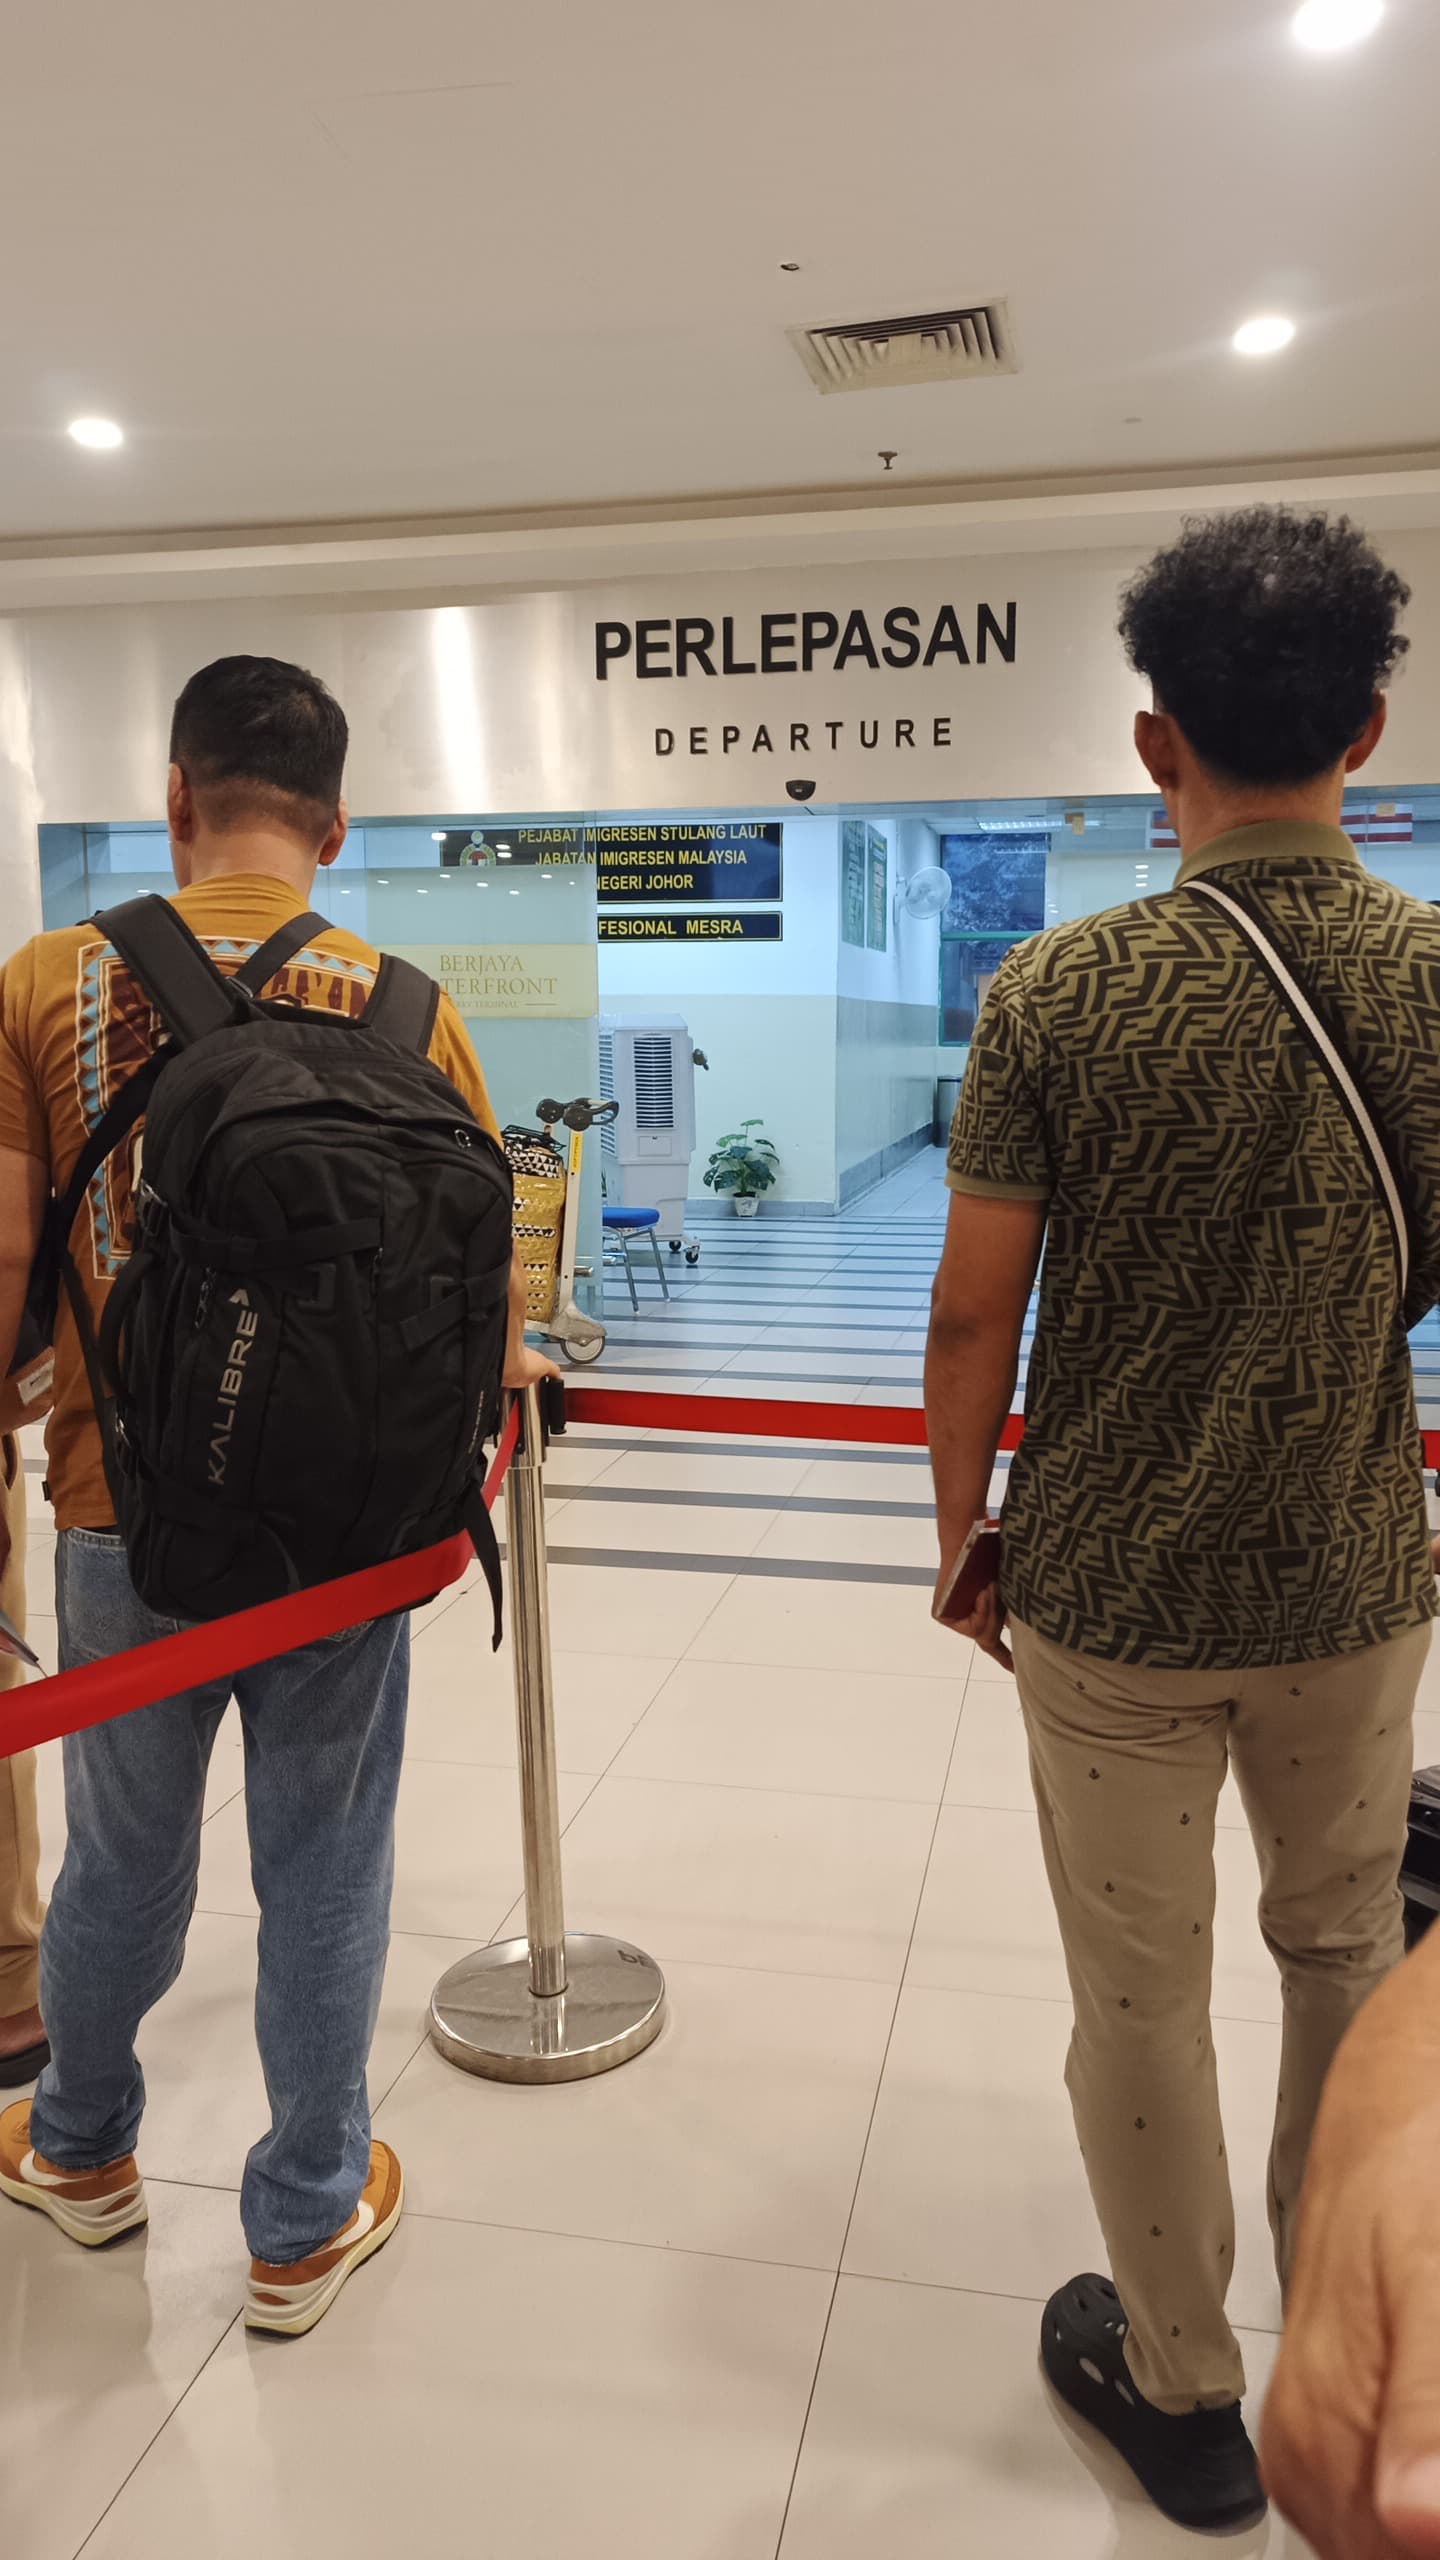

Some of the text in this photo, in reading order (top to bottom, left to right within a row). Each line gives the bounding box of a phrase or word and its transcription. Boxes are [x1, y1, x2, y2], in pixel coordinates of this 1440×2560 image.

[595, 602, 1017, 680] PERLEPASAN
[655, 717, 952, 756] DEPARTURE
[518, 824, 766, 843] PEJABAT IMIGRESEN STULANG LAUT
[535, 850, 747, 866] JABATAN IMIGRESEN MALAYSIA
[645, 874, 694, 890] JOHOR
[598, 919, 744, 936] FESIONAL MESRA
[440, 954, 524, 975] BERJAYA
[440, 978, 557, 995] TERFRONT
[207, 1309, 259, 1486] KALIBRE
